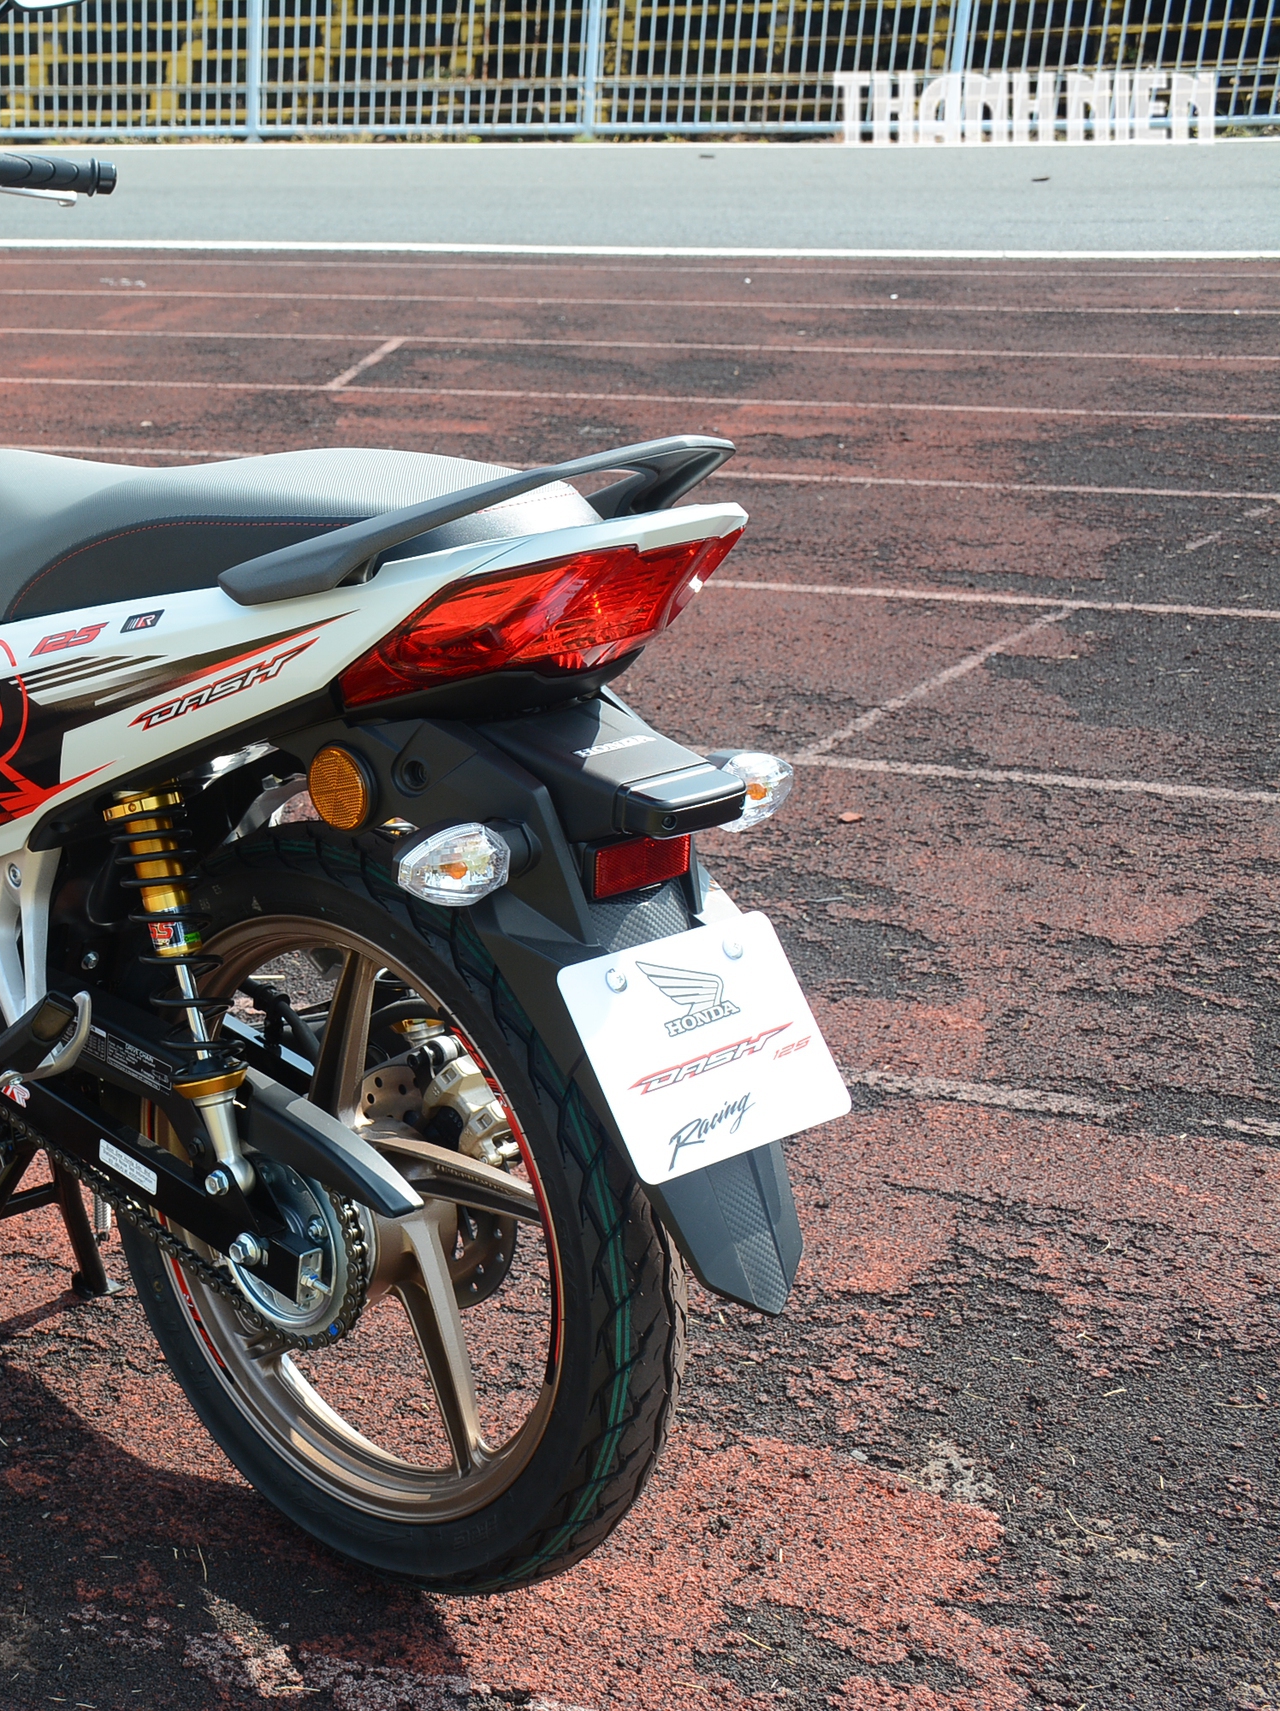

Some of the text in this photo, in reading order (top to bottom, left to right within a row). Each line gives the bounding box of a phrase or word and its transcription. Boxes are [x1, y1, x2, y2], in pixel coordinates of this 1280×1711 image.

[28, 621, 110, 658] 125
[127, 636, 320, 732] DASH
[571, 734, 658, 759] HONDA
[664, 1000, 740, 1037] HONDA
[627, 1021, 811, 1096] DASH 125
[668, 1092, 756, 1172] Racing
